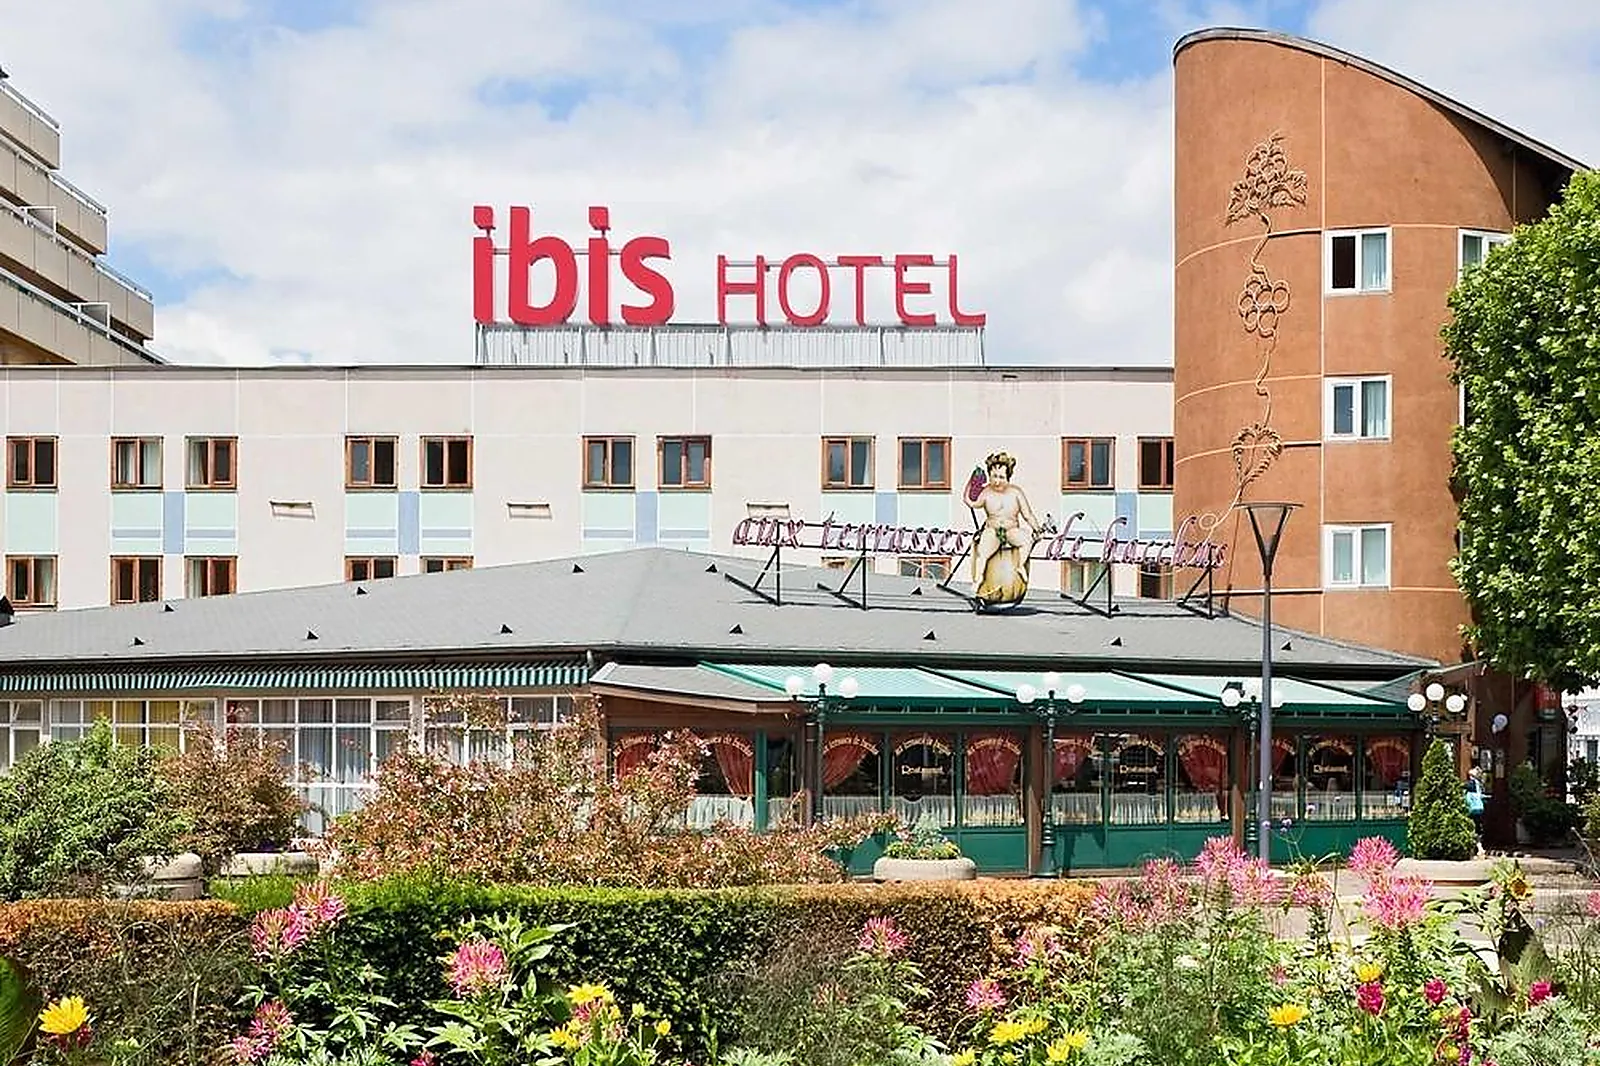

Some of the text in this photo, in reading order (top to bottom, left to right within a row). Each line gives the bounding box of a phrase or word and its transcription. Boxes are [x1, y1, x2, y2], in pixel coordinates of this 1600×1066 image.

[473, 206, 986, 326] ibis HOTEL
[733, 511, 1228, 569] aux terrasses de bacchus
